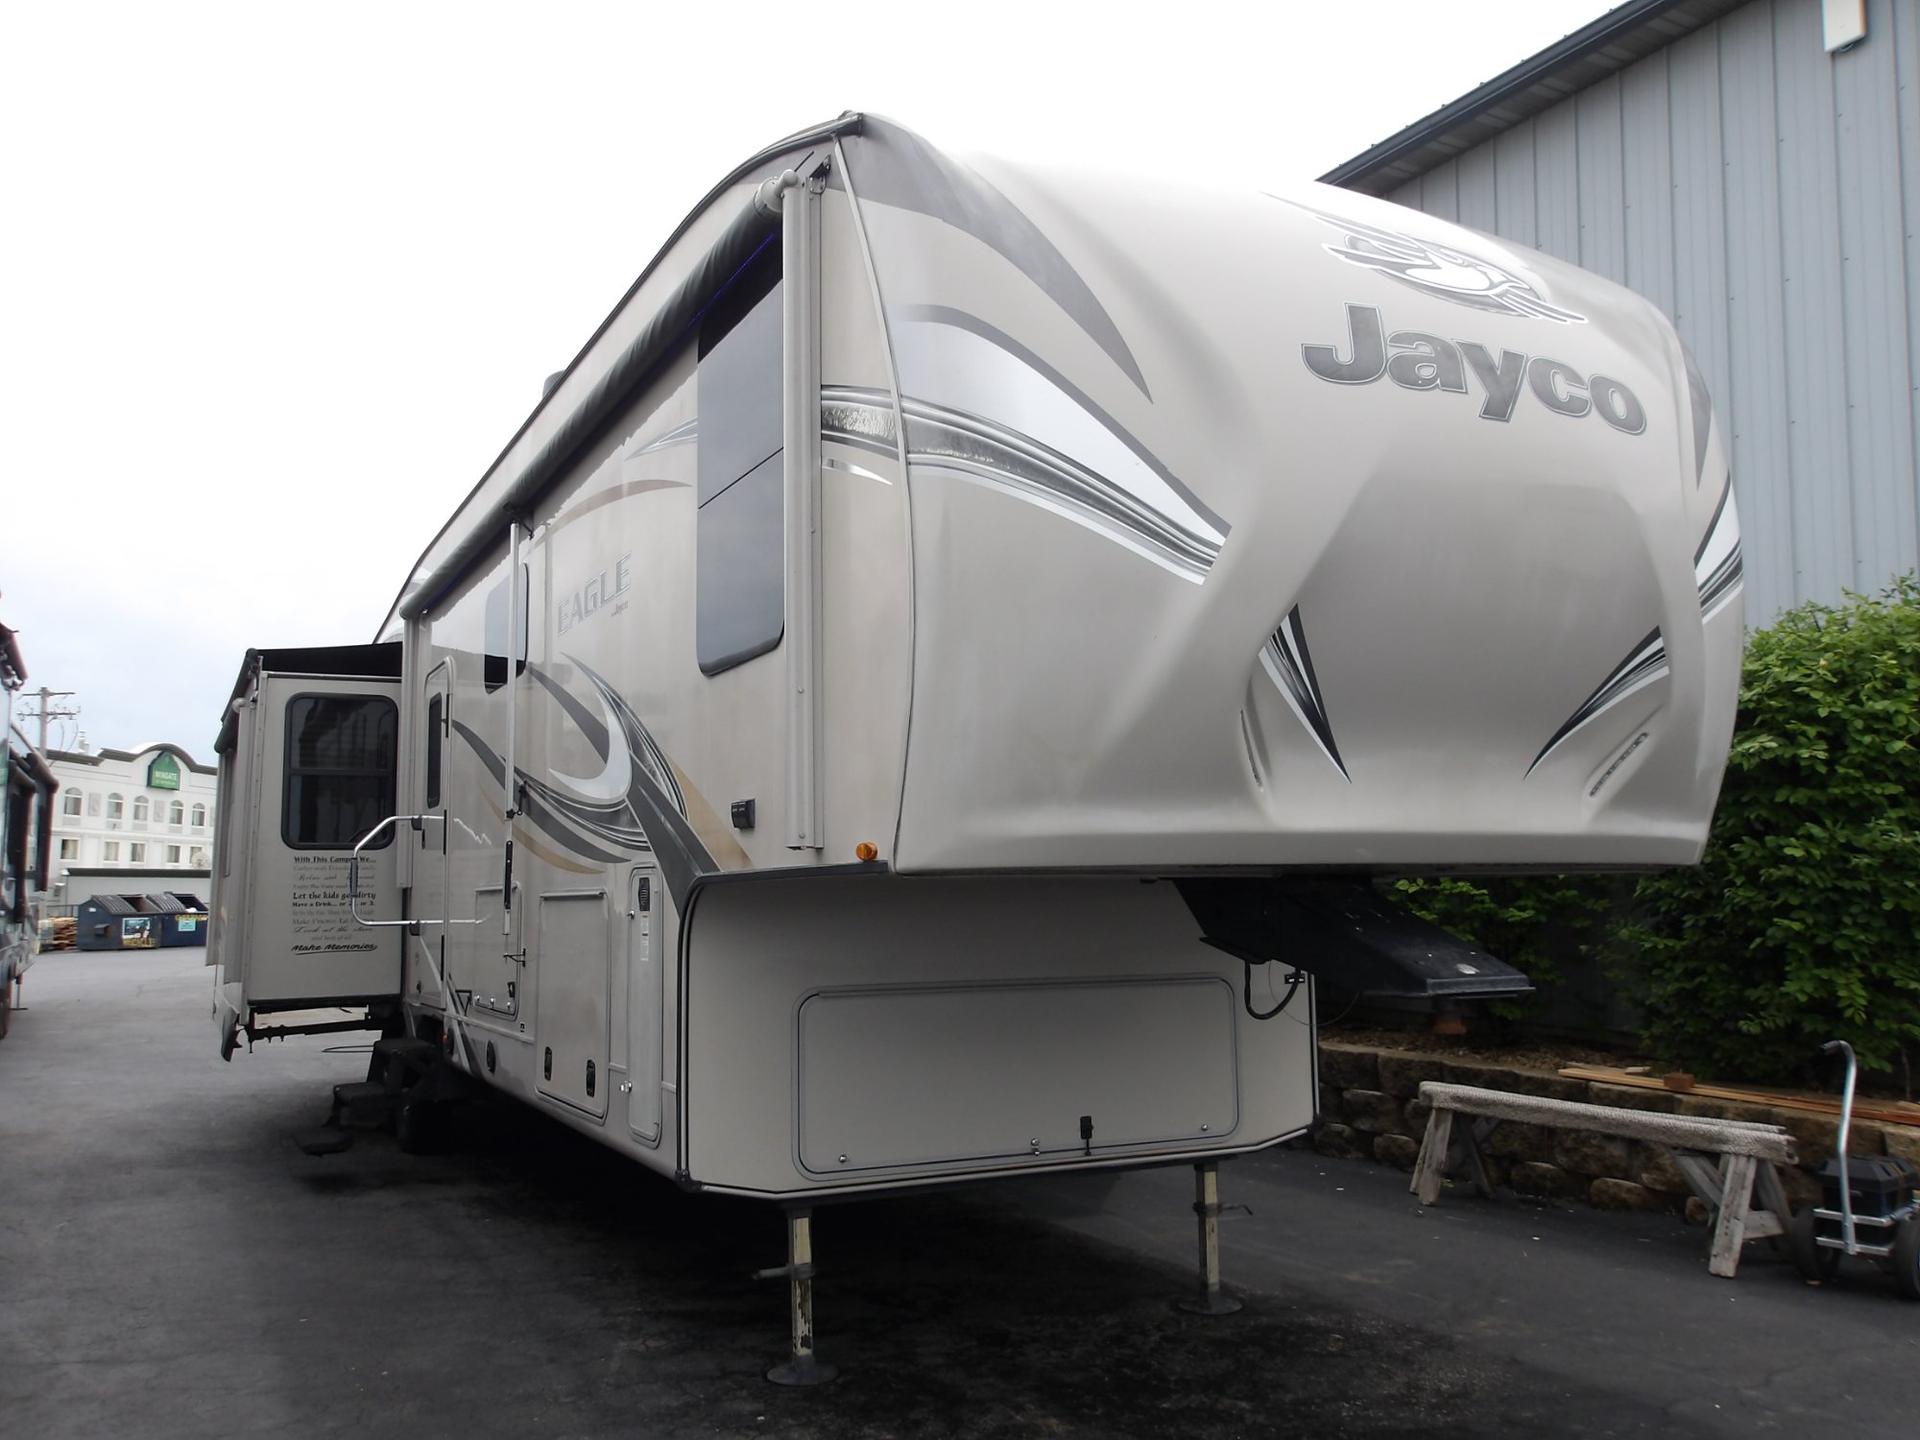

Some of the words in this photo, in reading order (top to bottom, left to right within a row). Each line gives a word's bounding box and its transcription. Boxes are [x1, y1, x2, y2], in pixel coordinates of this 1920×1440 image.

[1301, 302, 1647, 435] Jayco
[557, 551, 632, 637] EAGLE
[308, 891, 321, 899] the
[323, 891, 339, 899] kids
[291, 944, 322, 952] Make
[324, 943, 377, 952] Memories
